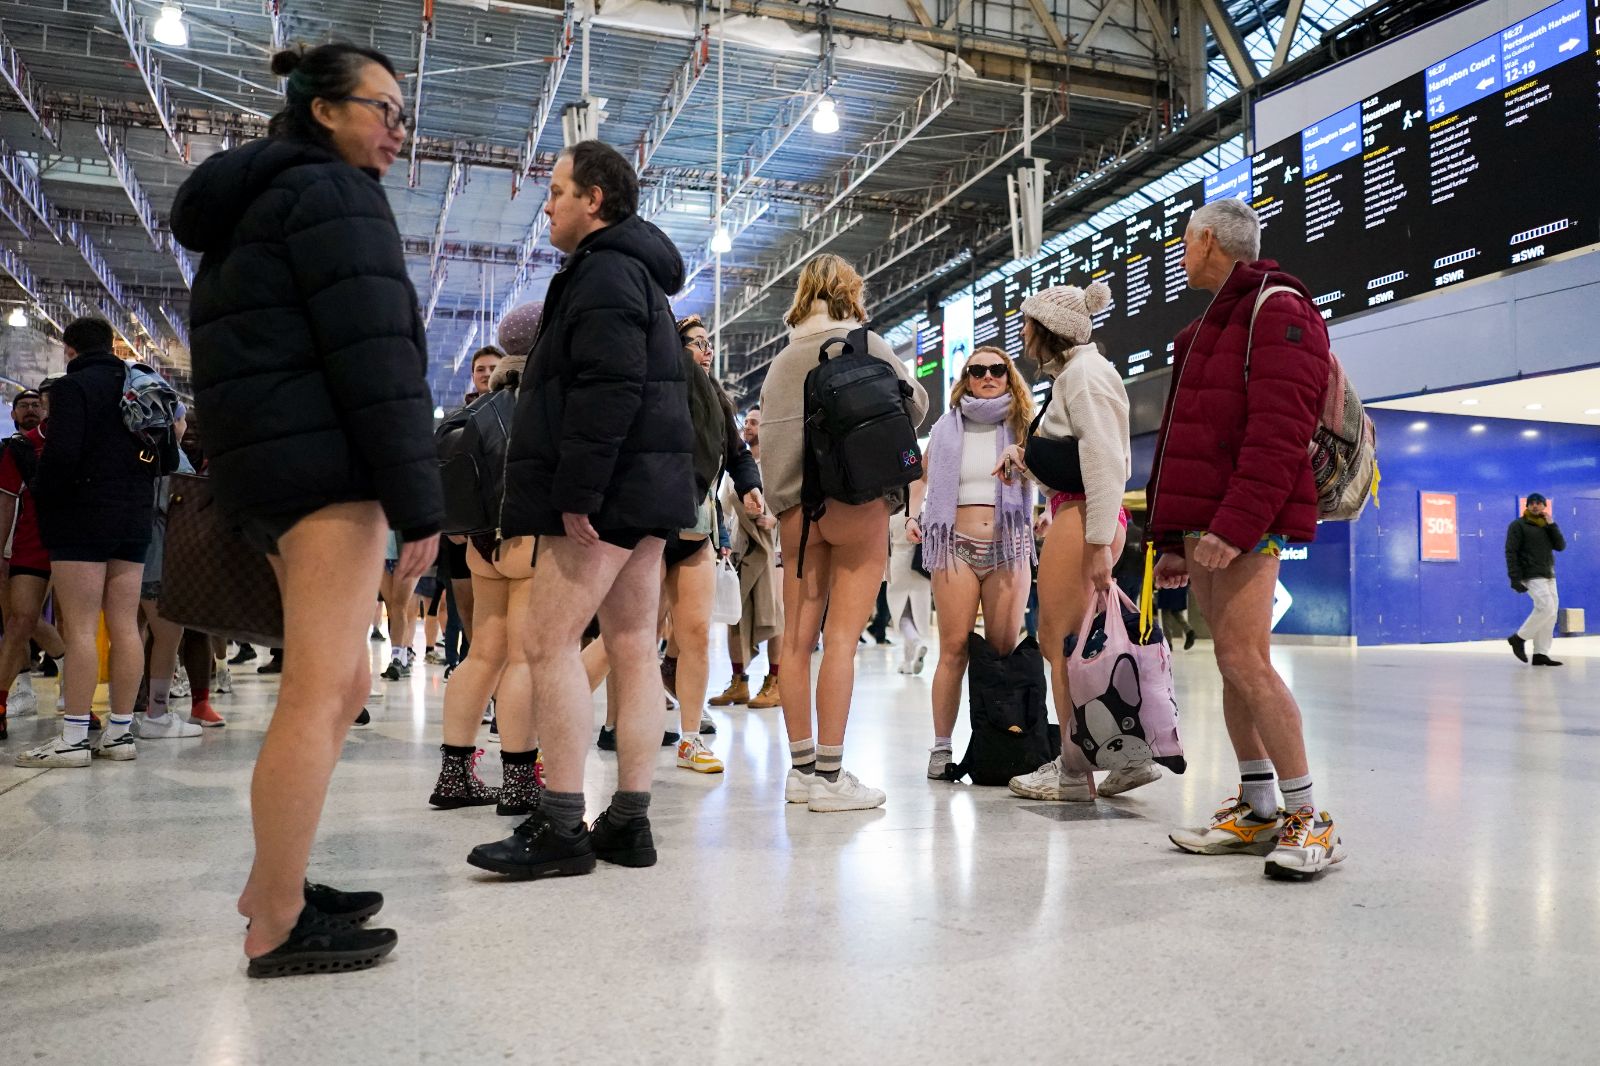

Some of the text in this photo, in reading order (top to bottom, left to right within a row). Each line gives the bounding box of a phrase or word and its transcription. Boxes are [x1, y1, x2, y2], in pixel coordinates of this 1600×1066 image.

[1503, 24, 1523, 40] 16:27
[1504, 26, 1547, 52] Portsmouth
[1548, 10, 1581, 30] Harbour
[1511, 42, 1534, 56] Guildford
[1504, 59, 1519, 70] Wait
[1505, 60, 1535, 82] 12-19
[1429, 54, 1495, 92] Hampton Court
[1429, 95, 1442, 105] Wait
[1363, 100, 1401, 124] Hounslow
[1430, 102, 1445, 116] 1-6
[1304, 122, 1356, 151] Chessington South
[1363, 134, 1374, 147] 19
[1521, 244, 1544, 260] SWR
[1443, 269, 1464, 284] SWR
[1375, 290, 1394, 304] SWR
[1428, 518, 1453, 534] 50%
